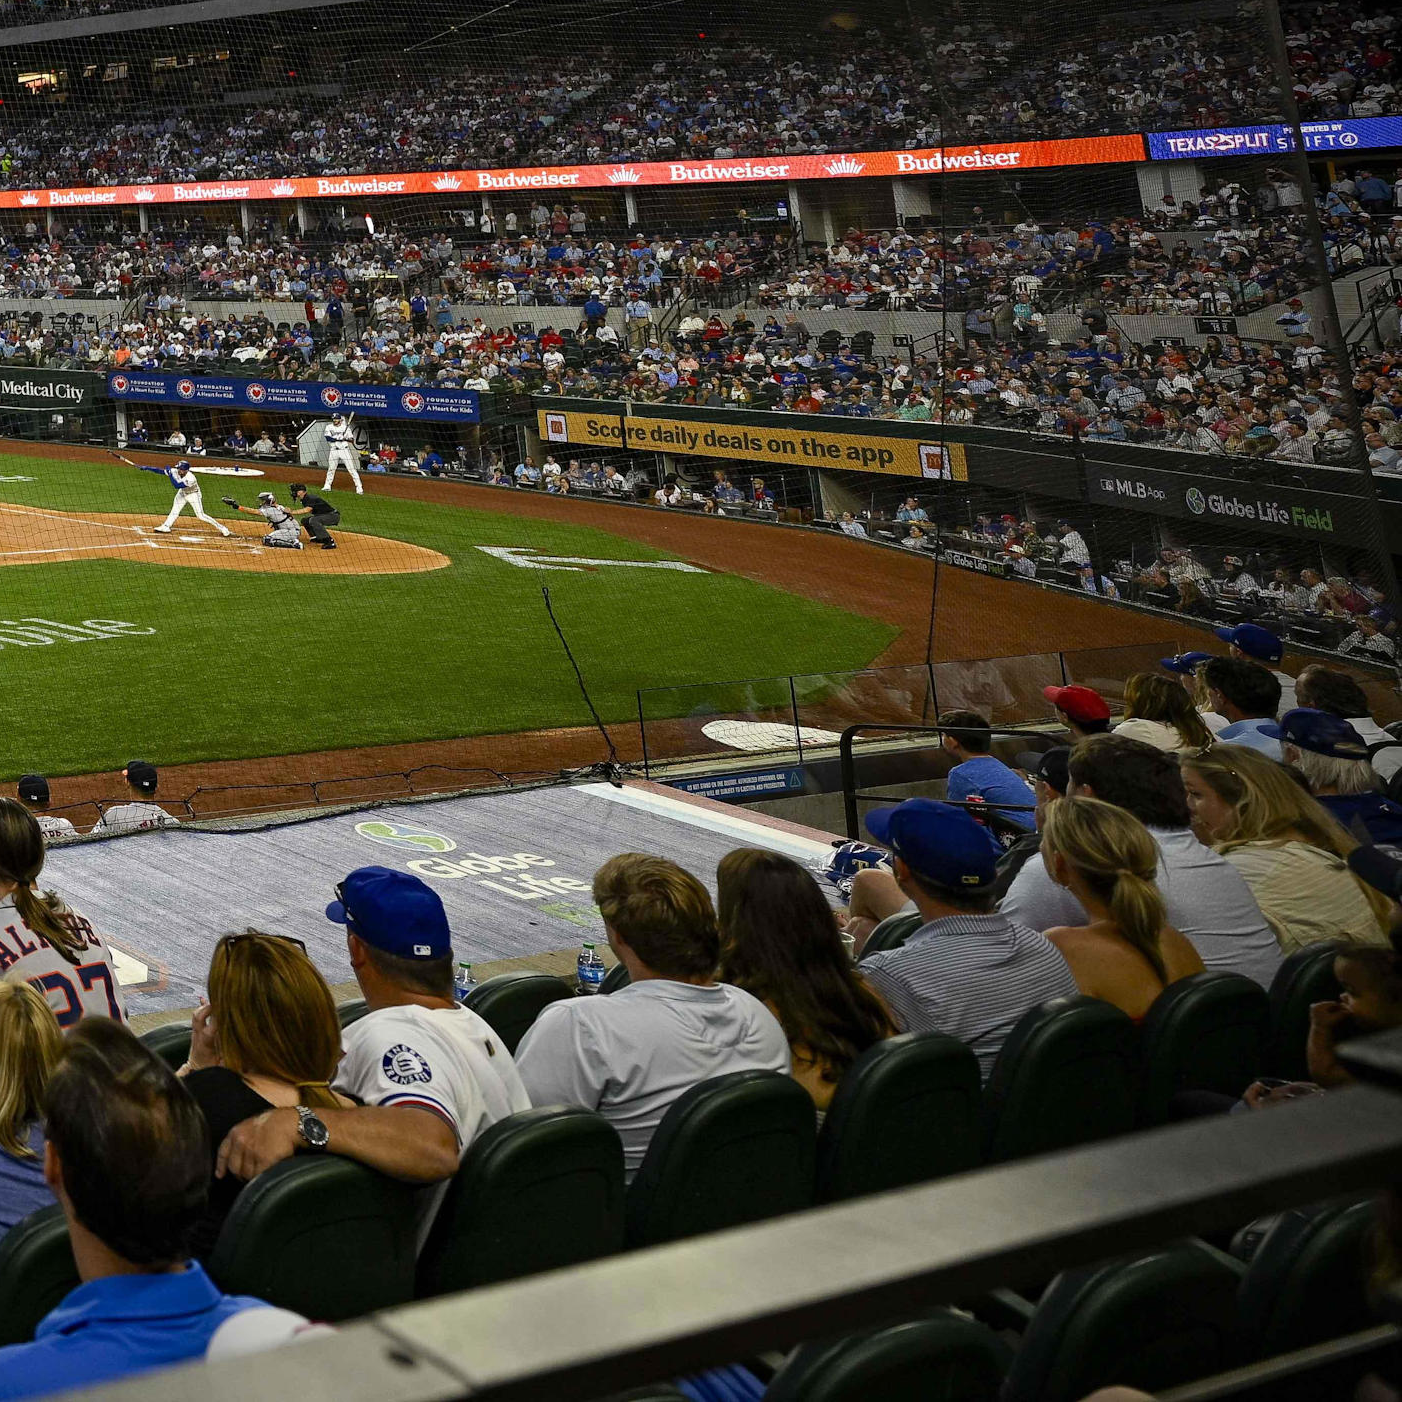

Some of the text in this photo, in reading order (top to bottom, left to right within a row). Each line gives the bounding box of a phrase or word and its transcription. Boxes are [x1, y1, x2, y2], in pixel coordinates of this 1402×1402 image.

[896, 150, 1021, 174] Budweiser
[477, 171, 580, 190] Budweiser
[669, 163, 790, 182] Budweiser
[173, 185, 250, 201] Budweiser
[317, 179, 405, 195] Budweiser
[50, 191, 117, 205] Budweiser
[130, 379, 165, 387] FOUNDATION
[196, 383, 233, 391] FOUNDATION
[268, 387, 308, 395] FOUNDATION
[0, 380, 85, 403] Medical City
[344, 392, 386, 400] FOUNDATION
[426, 397, 472, 405] FOUNDATION
[432, 405, 449, 413] Heart
[459, 407, 473, 415] Kids
[586, 419, 894, 469] Score daily deals on the app
[1115, 478, 1148, 498] MLB
[1208, 494, 1334, 533] Globe Life Field
[953, 554, 987, 571] Globe Life
[407, 852, 593, 900] Globe Life
